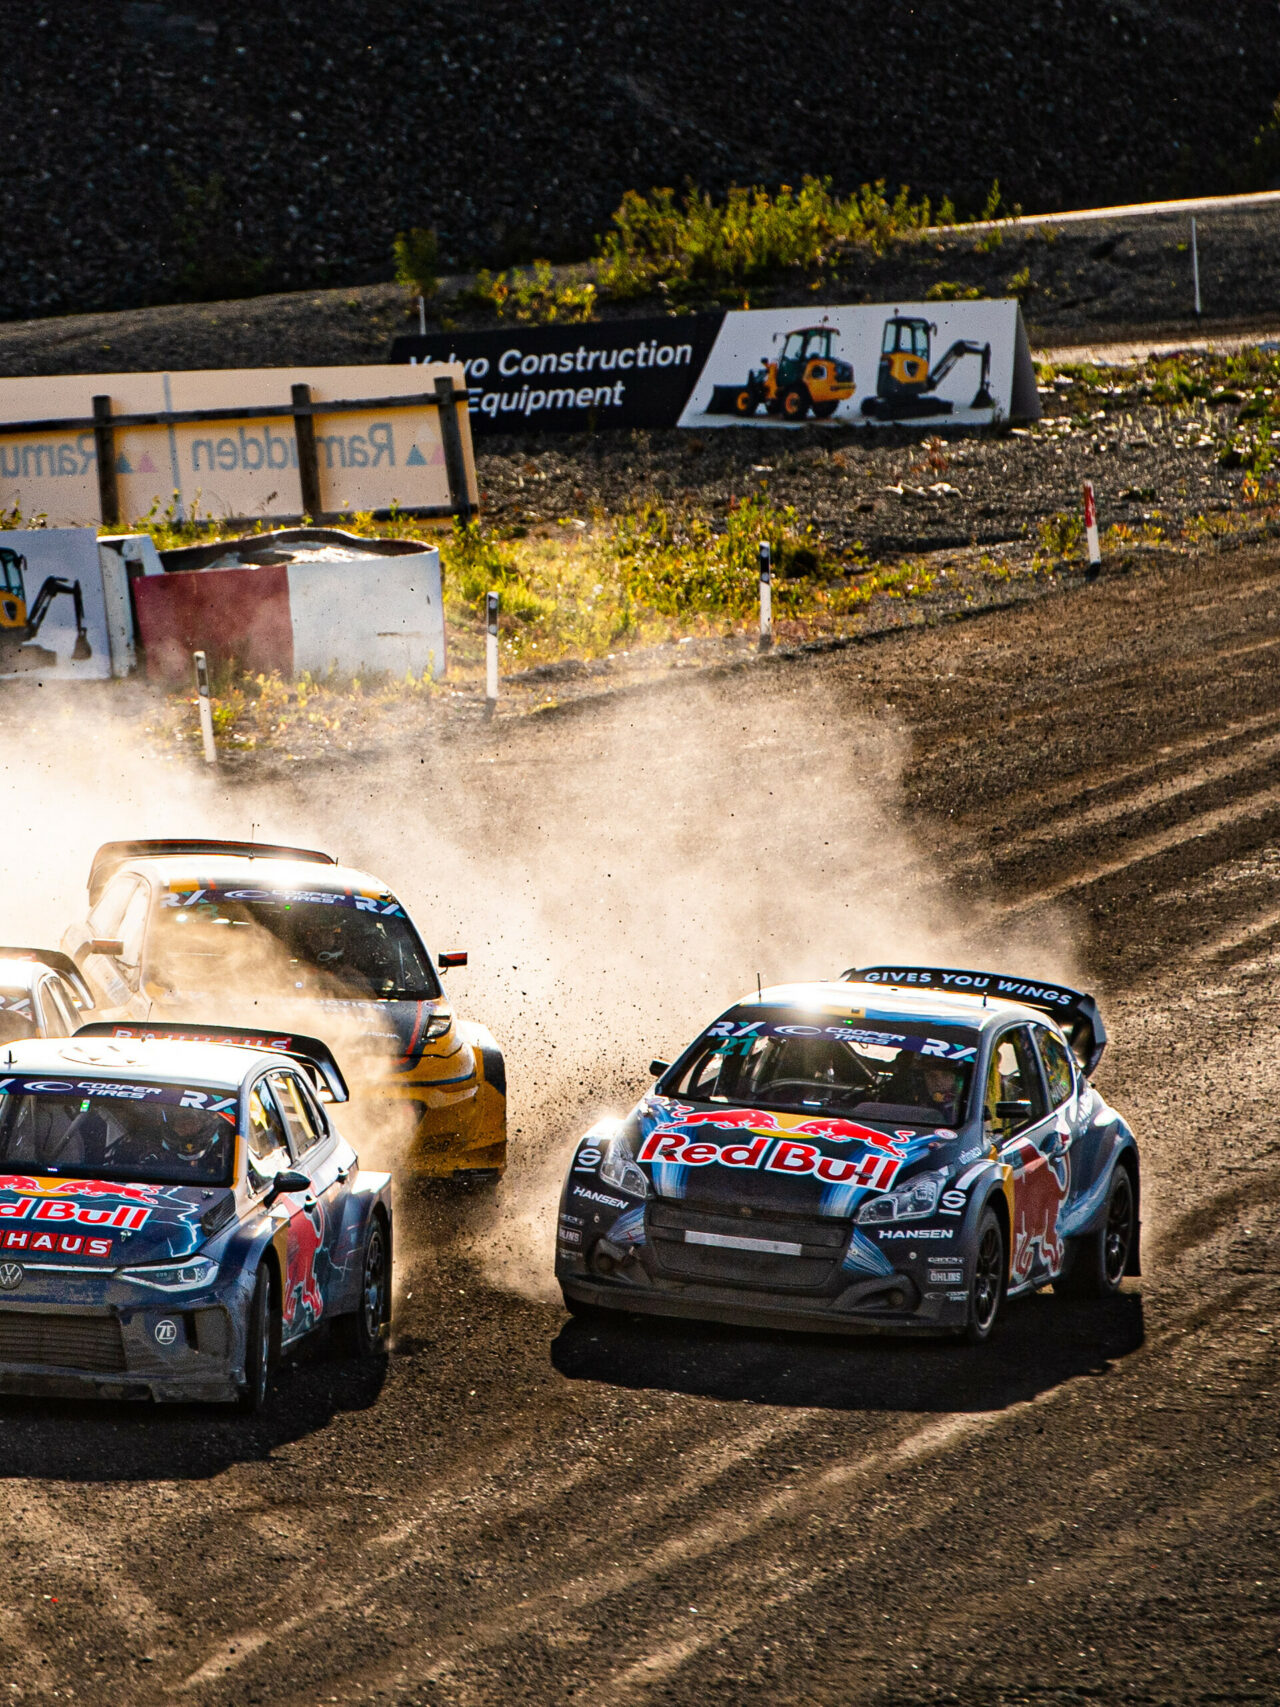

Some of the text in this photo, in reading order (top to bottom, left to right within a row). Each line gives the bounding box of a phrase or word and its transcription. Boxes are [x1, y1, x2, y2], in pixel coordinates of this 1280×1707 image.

[498, 339, 693, 376] Construction
[467, 380, 625, 418] Equipment
[864, 971, 1073, 1005] GIVES YOU WINGS
[825, 1026, 906, 1042] COOPER
[834, 1033, 891, 1045] TIRES
[709, 1036, 756, 1056] 21
[77, 1081, 163, 1095] COOPER
[87, 1088, 147, 1100] TIRES
[639, 1133, 903, 1191] Red Bull
[573, 1185, 629, 1210] HANSEN
[34, 1200, 150, 1230] Bull
[878, 1229, 954, 1239] HANSEN
